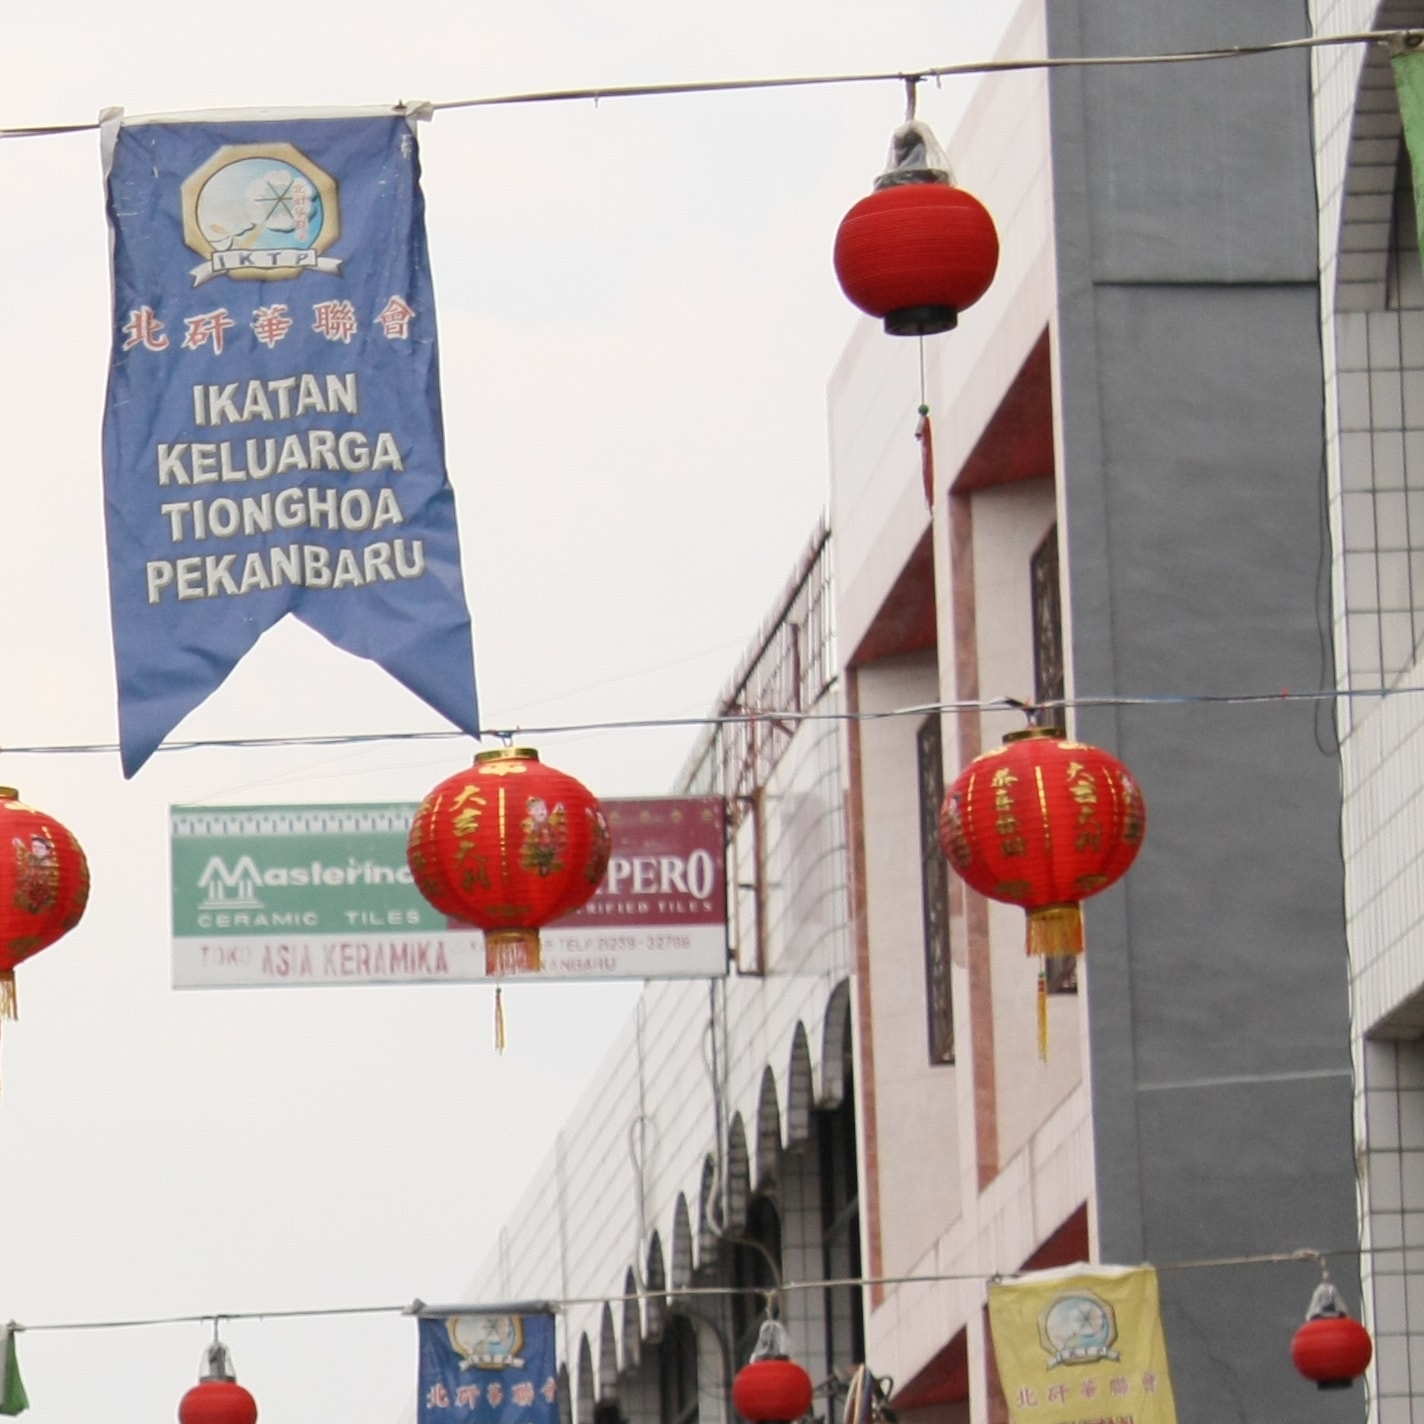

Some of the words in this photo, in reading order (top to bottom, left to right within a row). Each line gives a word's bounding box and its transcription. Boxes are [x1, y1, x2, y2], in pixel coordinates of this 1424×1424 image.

[217, 251, 312, 269] IKTP
[192, 372, 358, 428] IKATAN
[157, 429, 403, 487] KELUARGA
[161, 487, 403, 543] TIONGHOA
[146, 539, 426, 605] PEKANBARU
[198, 910, 319, 928] CERAMIC
[344, 910, 421, 926] TILES
[322, 941, 449, 978] KERAMIKA
